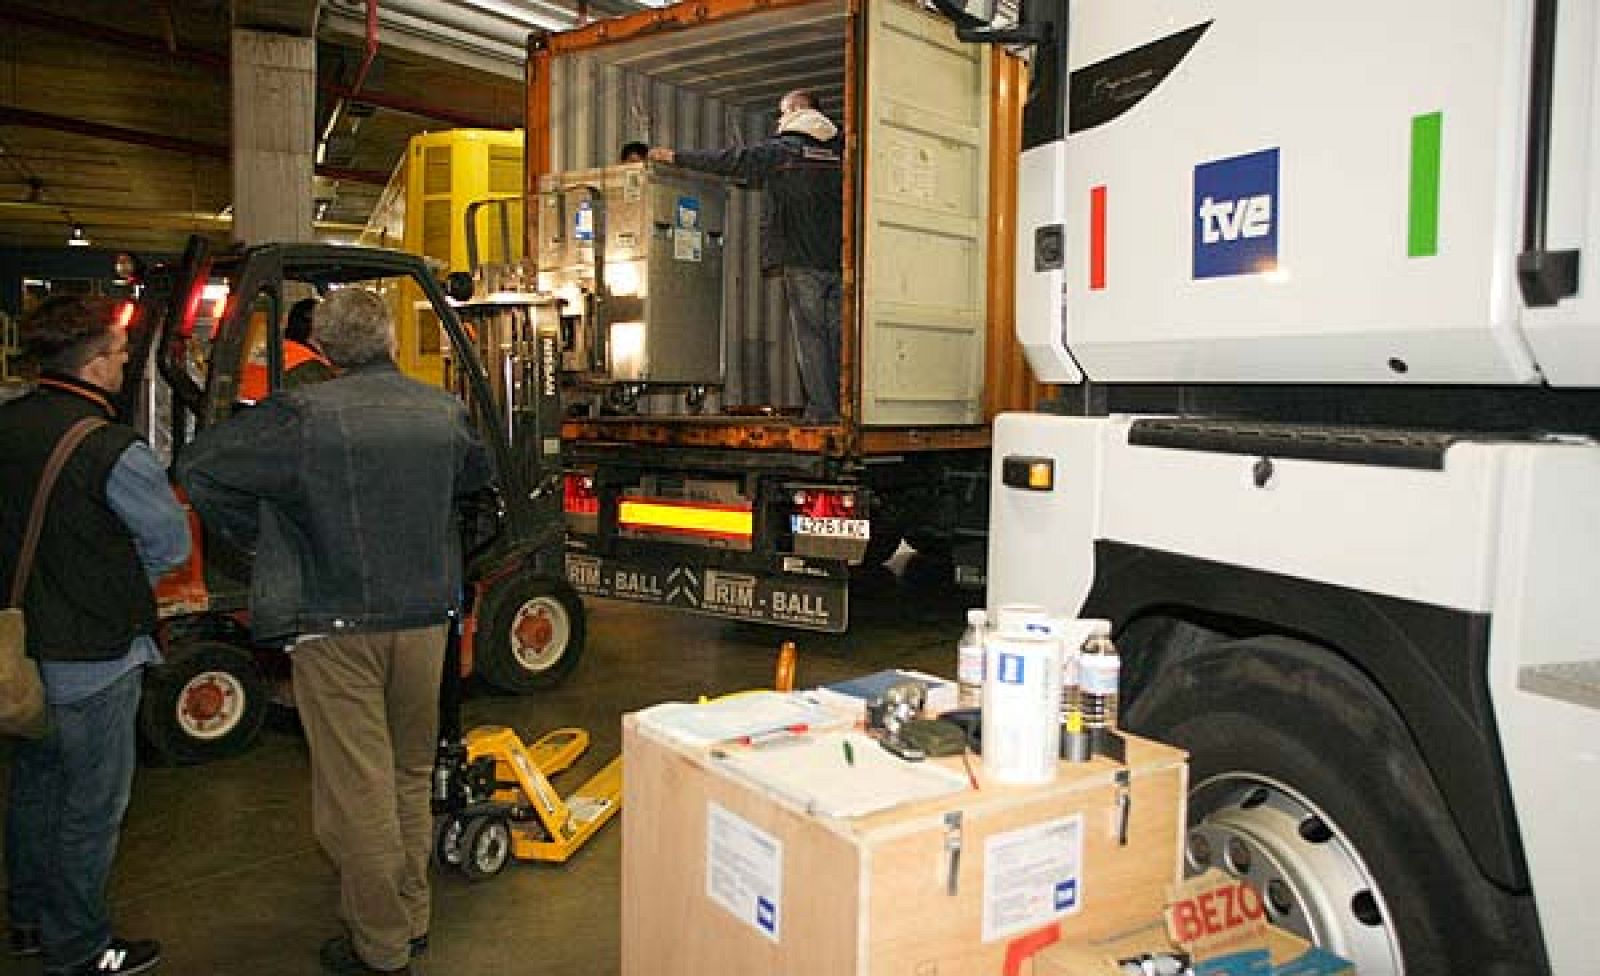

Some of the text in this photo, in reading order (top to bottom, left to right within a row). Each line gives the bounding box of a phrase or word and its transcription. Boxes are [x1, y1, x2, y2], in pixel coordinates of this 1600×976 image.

[1199, 194, 1270, 243] tve
[615, 570, 661, 596] BALL
[772, 591, 829, 617] BALL
[1172, 880, 1265, 942] BEZO
[98, 948, 127, 972] N
